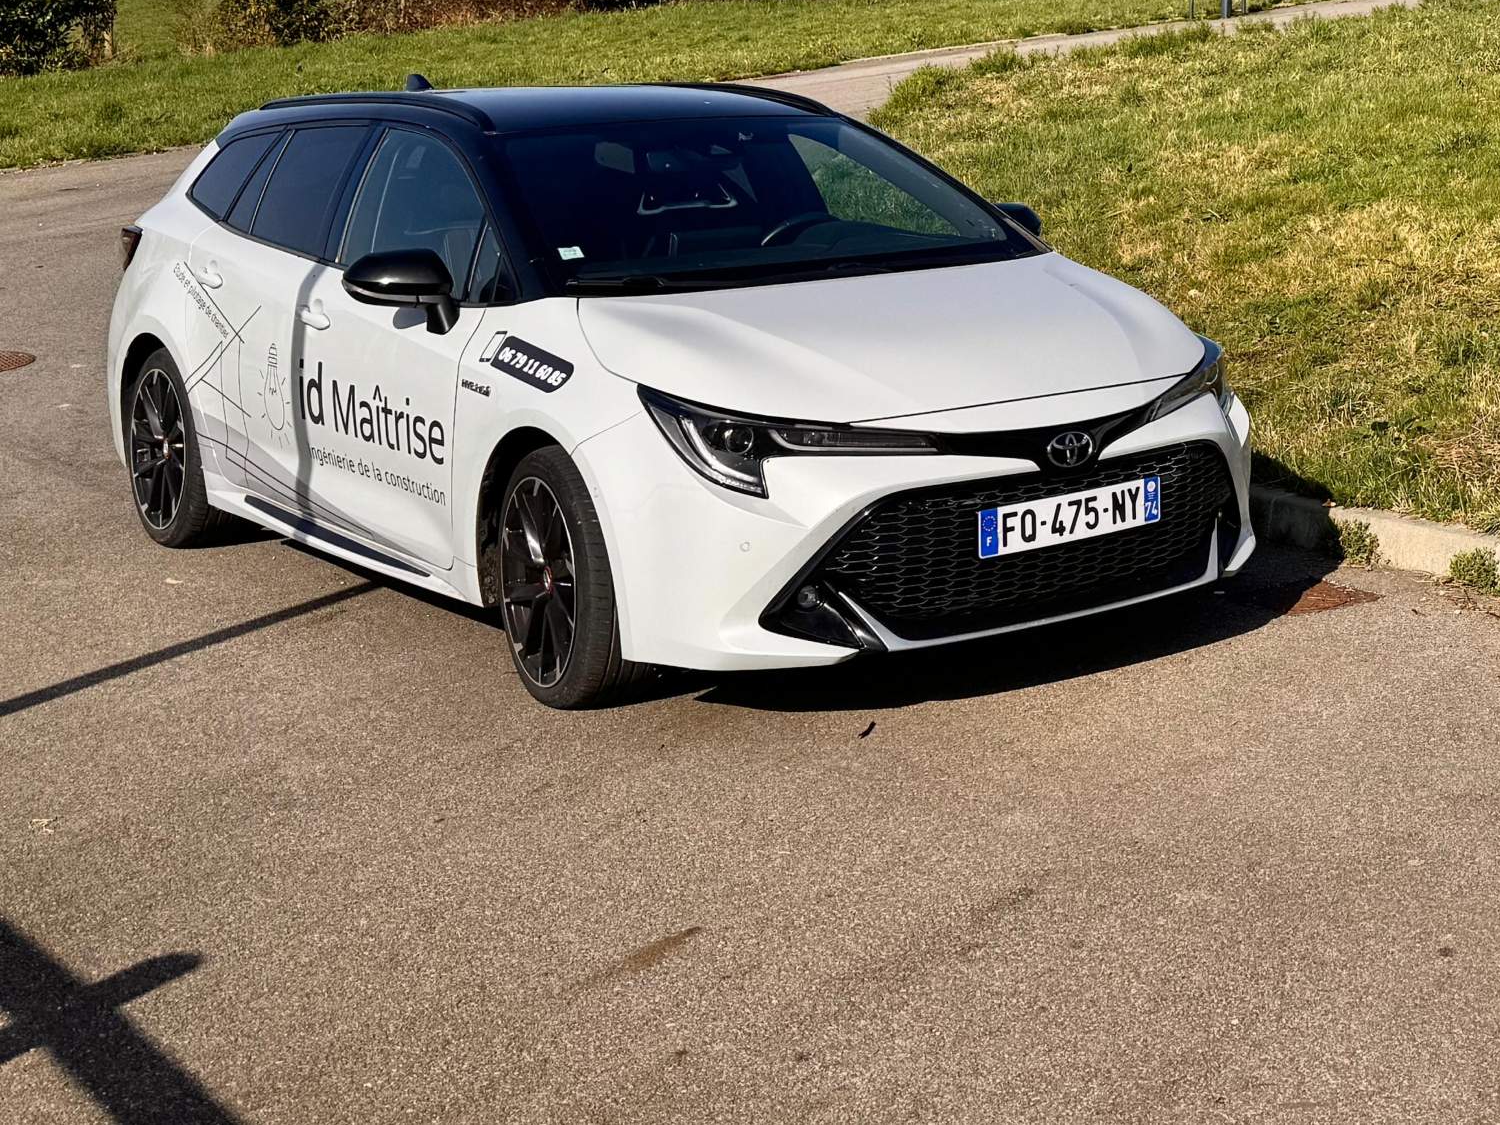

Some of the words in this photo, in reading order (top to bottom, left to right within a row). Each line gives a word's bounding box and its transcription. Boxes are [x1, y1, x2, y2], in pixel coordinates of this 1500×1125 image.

[299, 359, 326, 426] id
[332, 380, 445, 465] Maîtrise
[358, 459, 370, 479] de
[372, 463, 382, 482] la
[384, 471, 446, 506] construction
[1144, 501, 1158, 517] 74
[986, 536, 992, 547] F
